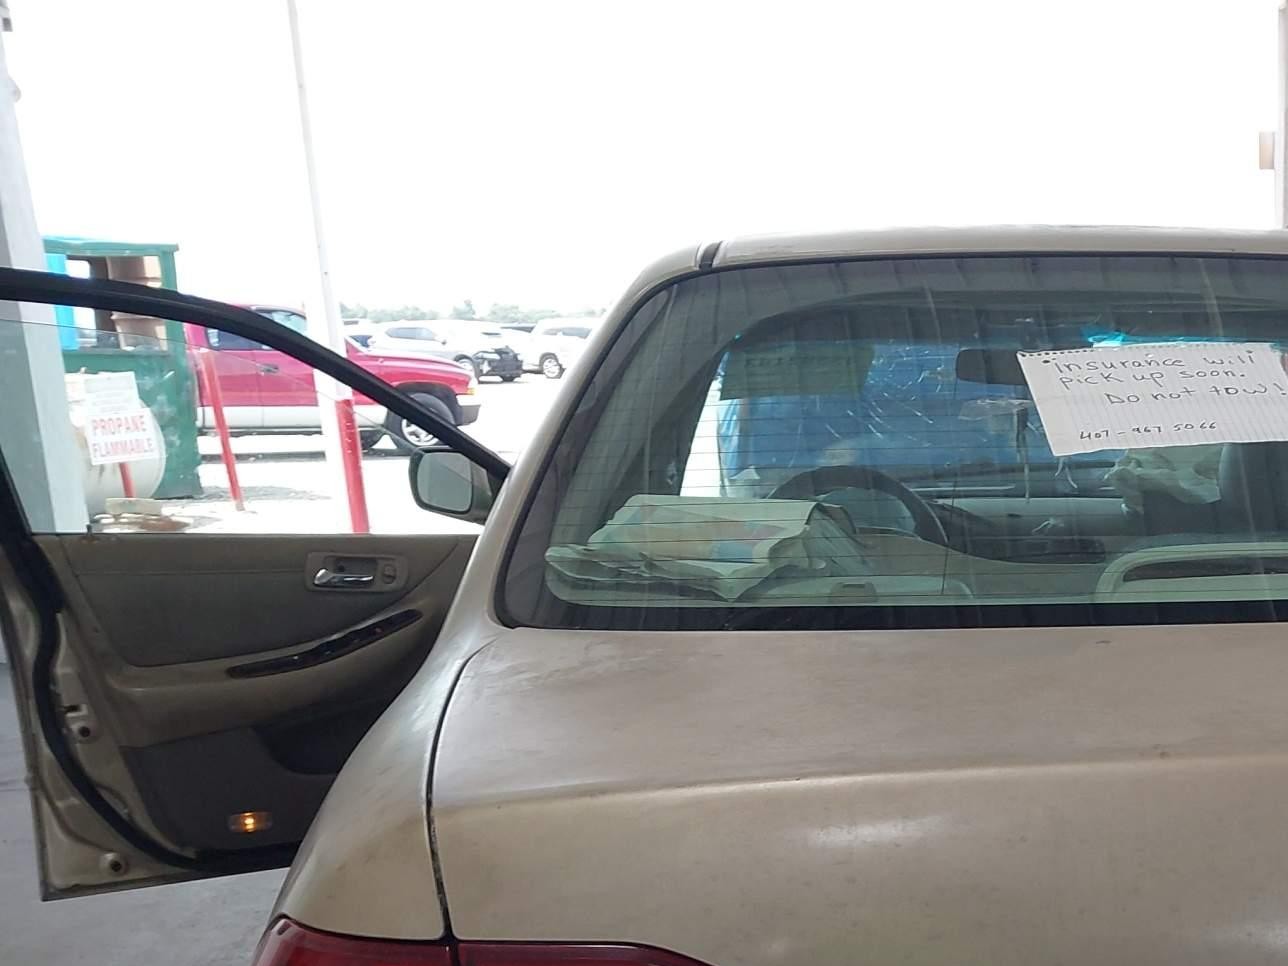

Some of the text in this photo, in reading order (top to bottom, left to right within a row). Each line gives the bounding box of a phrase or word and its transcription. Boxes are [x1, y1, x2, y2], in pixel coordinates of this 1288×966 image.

[1133, 370, 1166, 387] up
[1106, 391, 1140, 405] Do
[1152, 387, 1195, 401] not
[92, 415, 146, 436] PROPANE
[1080, 429, 1109, 441] 407
[92, 438, 154, 457] FLAMMABLE
